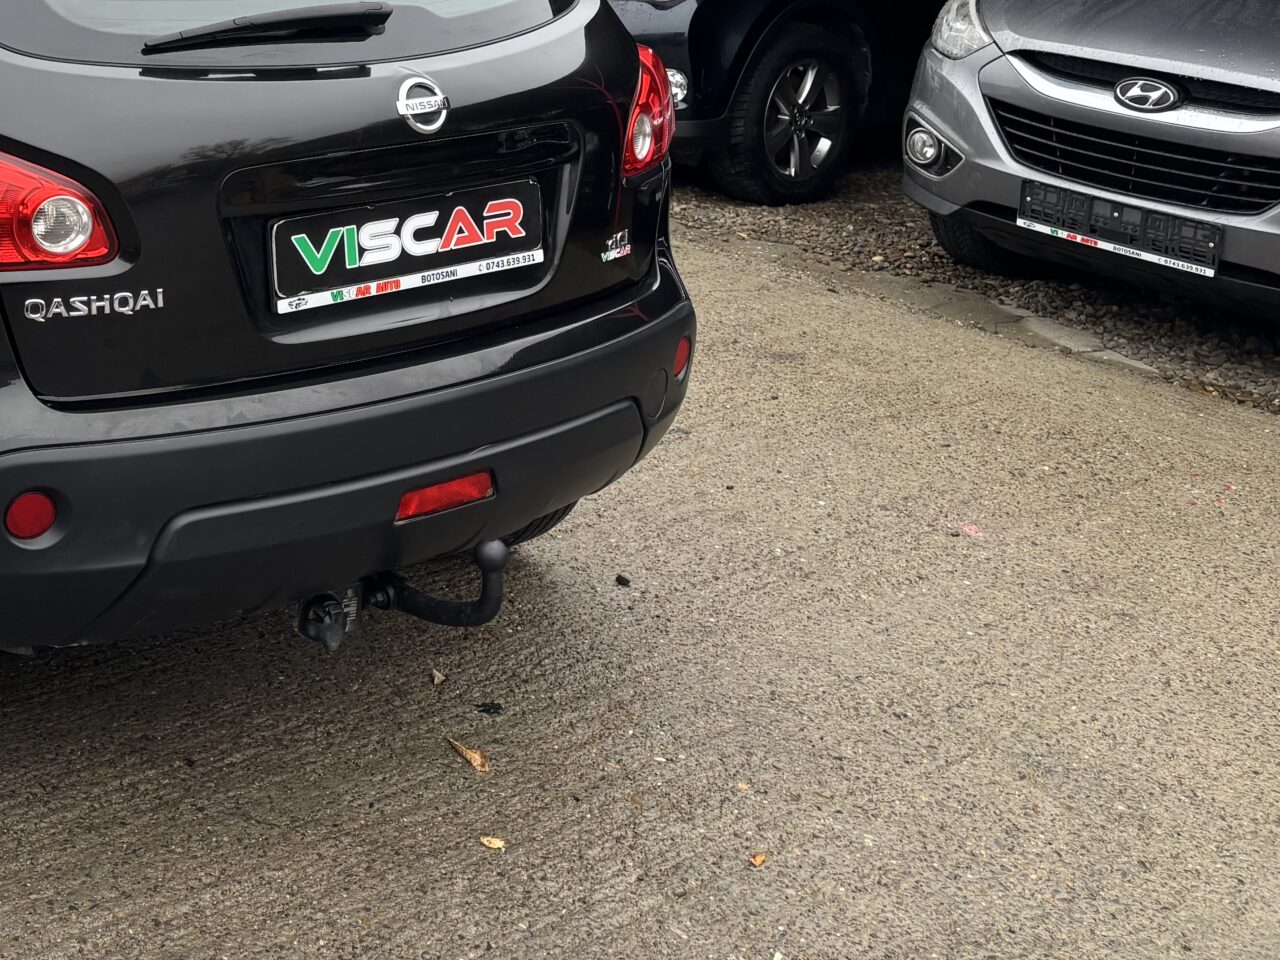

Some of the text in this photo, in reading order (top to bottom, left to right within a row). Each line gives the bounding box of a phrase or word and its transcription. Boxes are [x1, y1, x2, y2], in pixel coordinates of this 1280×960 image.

[404, 97, 449, 112] NISSAN
[291, 198, 527, 276] VISCAR
[600, 244, 632, 263] VISCAR
[1112, 245, 1143, 258] BOTOSANI
[1163, 258, 1208, 275] 0743.639.931
[375, 278, 401, 295] AUTO
[420, 267, 459, 285] BOTOSANI
[484, 252, 537, 273] 0743.639.931
